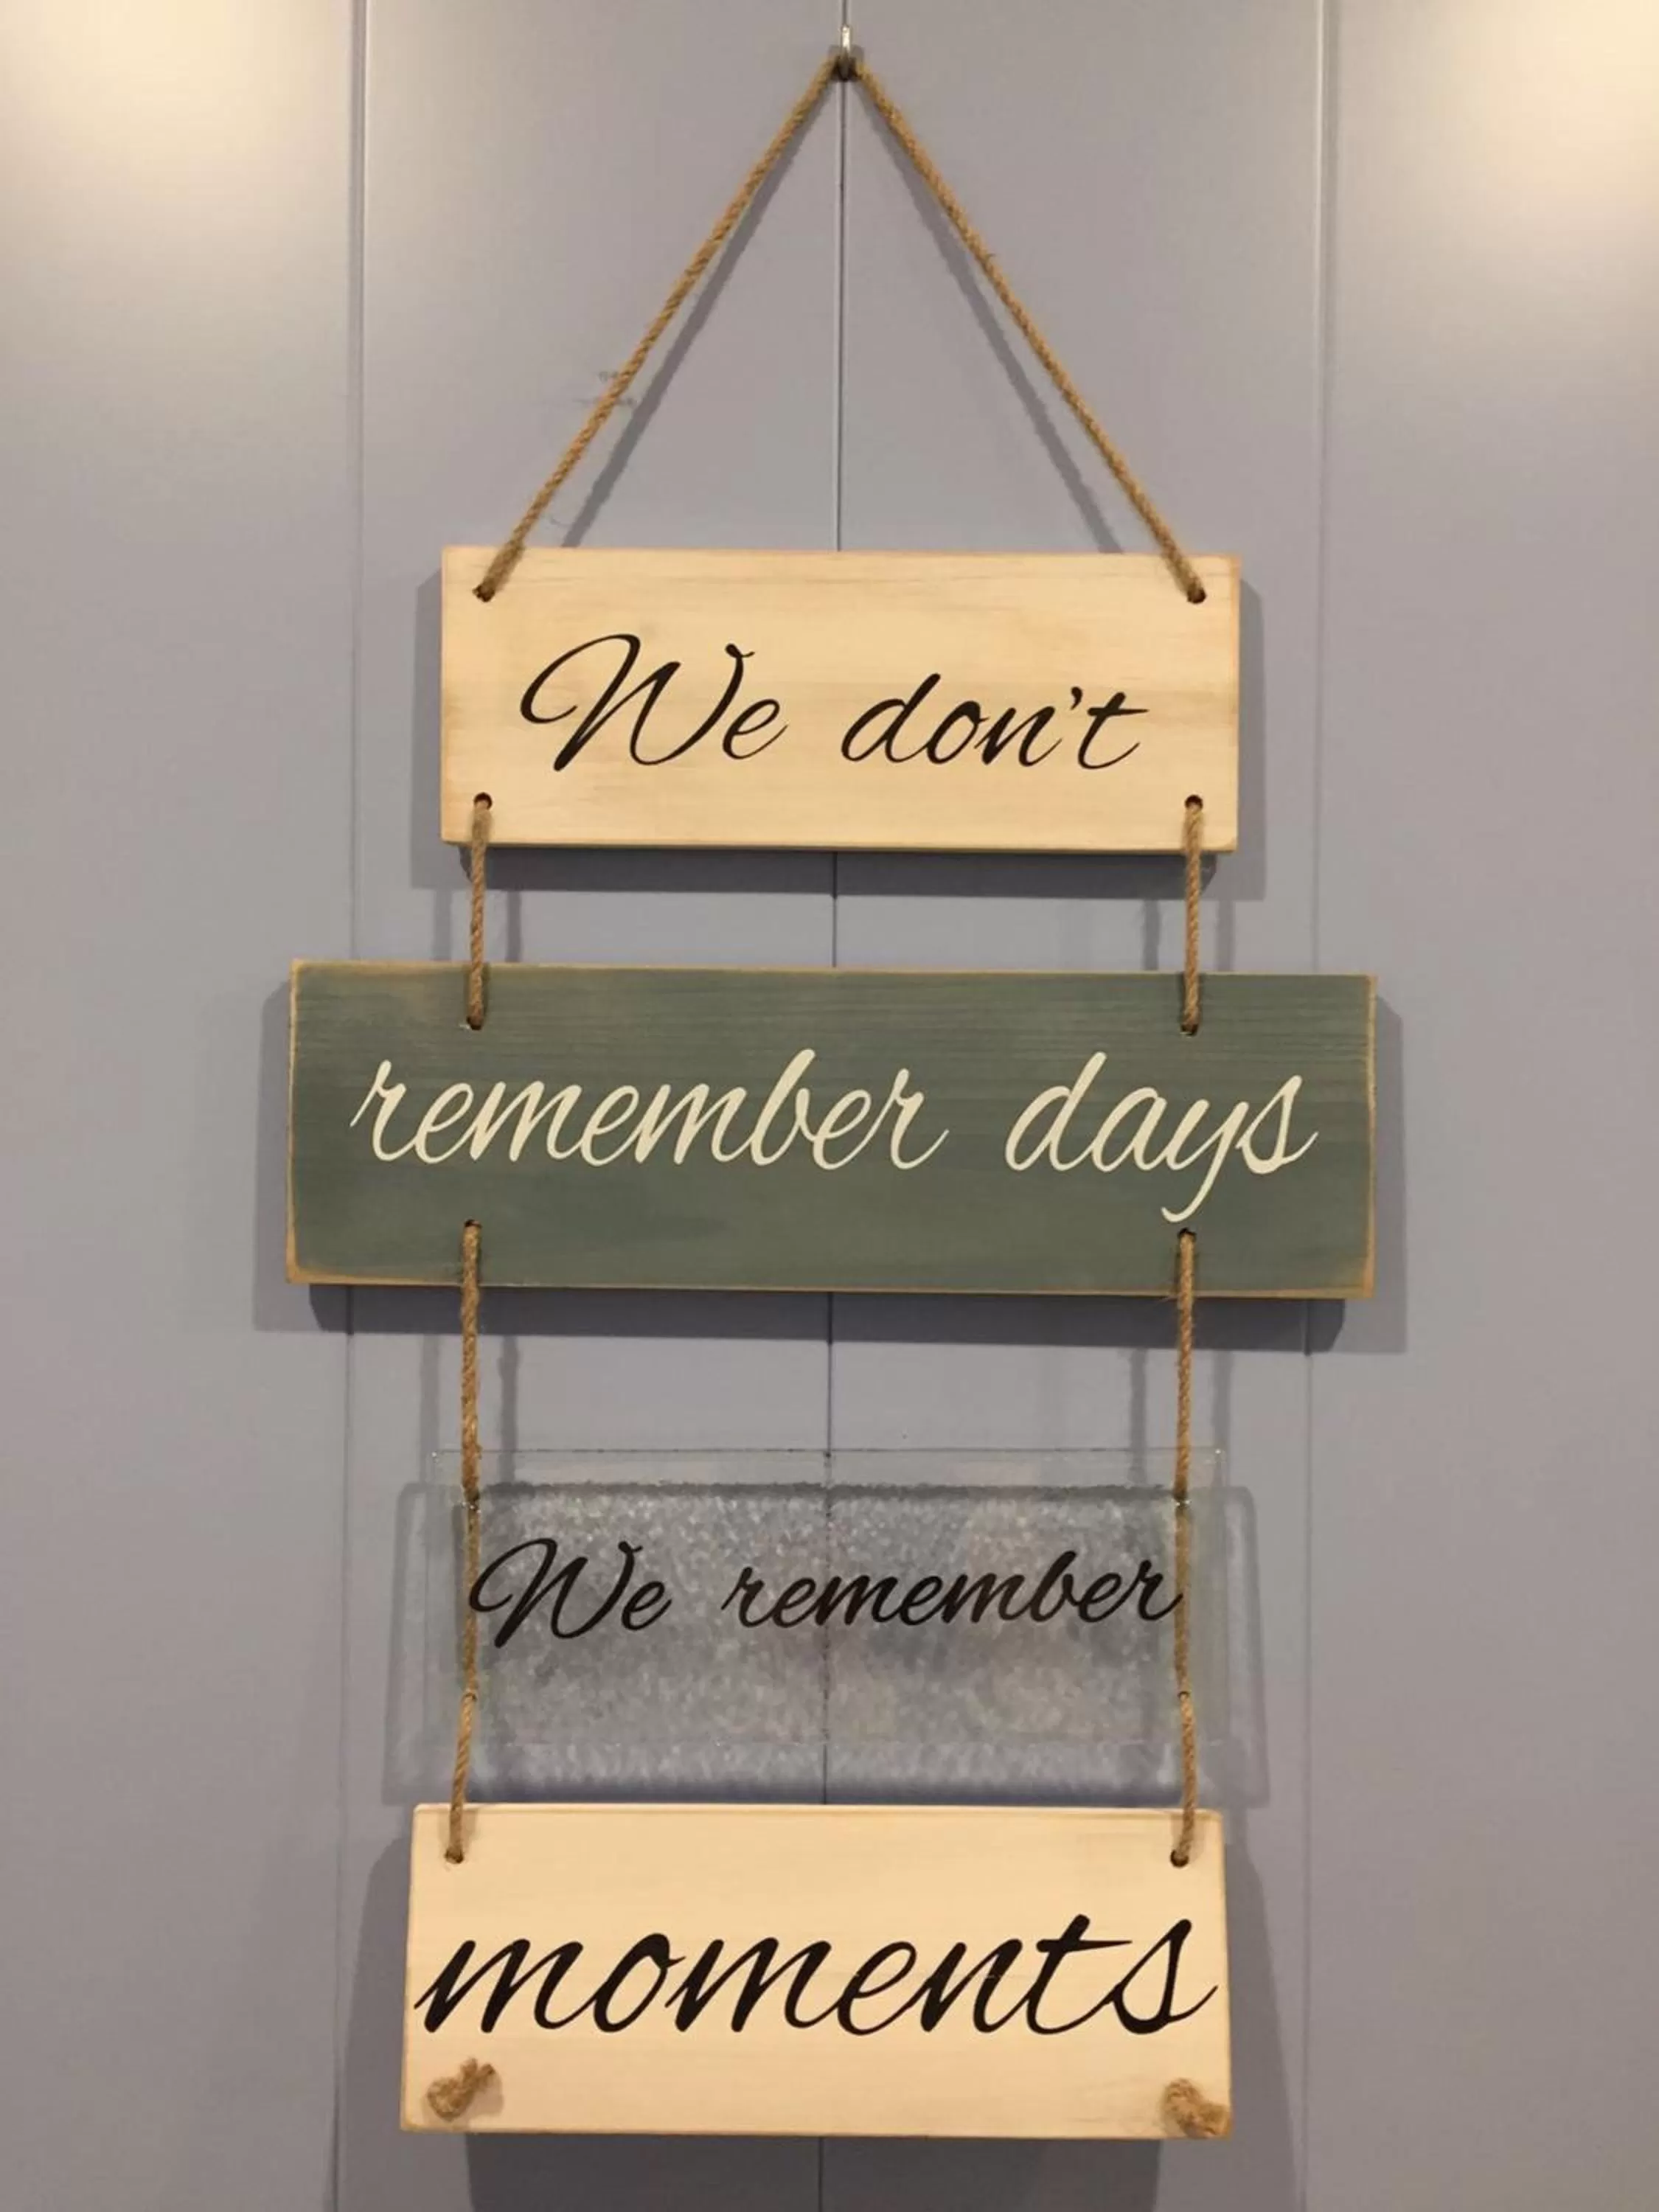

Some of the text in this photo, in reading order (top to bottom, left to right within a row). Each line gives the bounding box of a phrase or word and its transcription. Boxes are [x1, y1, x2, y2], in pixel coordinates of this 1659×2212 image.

[521, 634, 1149, 771] We don't
[350, 1049, 1318, 1222] remember days
[469, 1538, 1183, 1649] We remember
[414, 1914, 1218, 2036] moments
